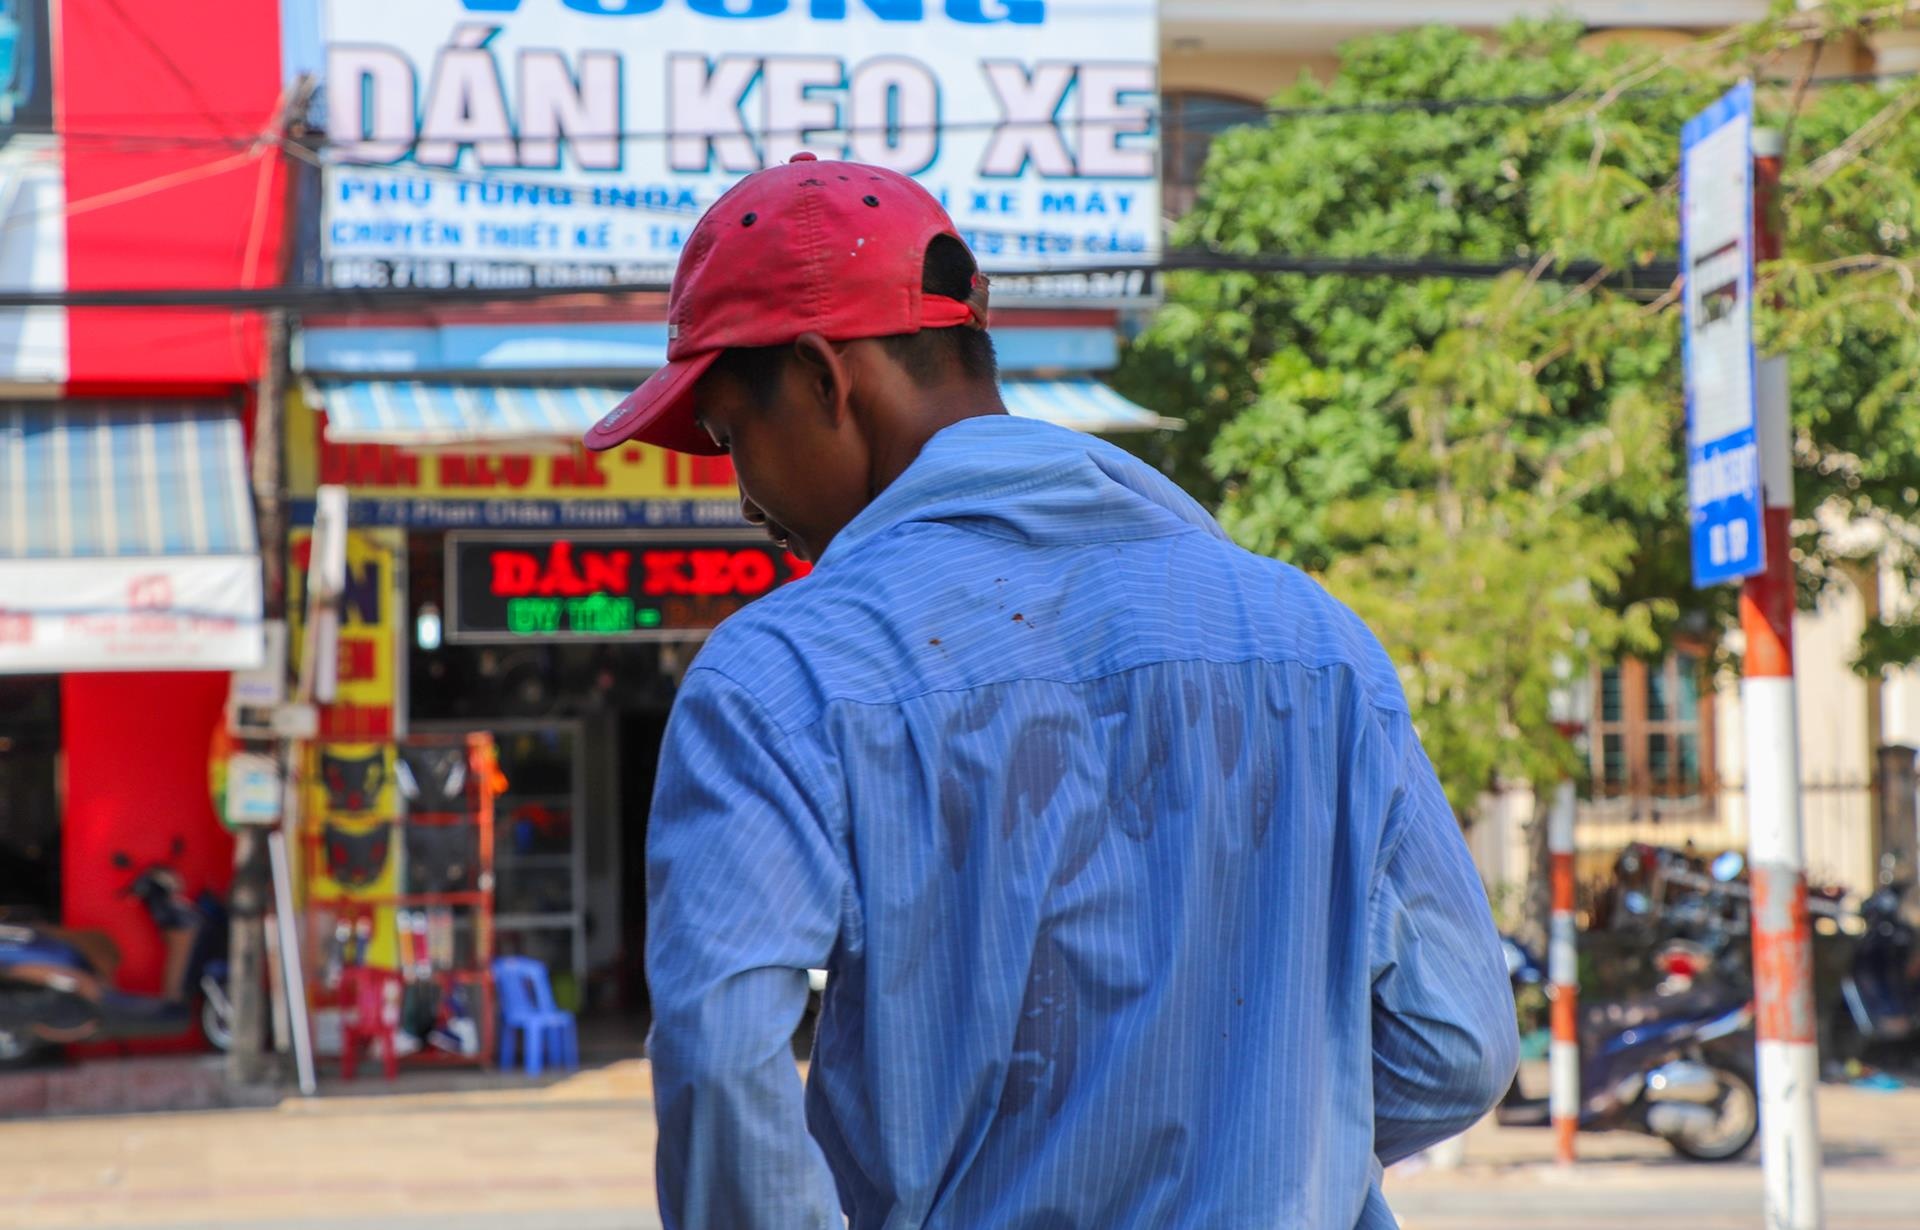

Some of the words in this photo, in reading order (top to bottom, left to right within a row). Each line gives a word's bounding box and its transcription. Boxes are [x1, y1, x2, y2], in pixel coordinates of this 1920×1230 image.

[327, 23, 623, 171] DÁN
[666, 53, 942, 175] KEO
[979, 58, 1157, 178] XE
[970, 190, 1018, 214] XE
[1041, 187, 1135, 215] MÁY
[490, 540, 632, 595] DÁN
[641, 549, 775, 595] KEO
